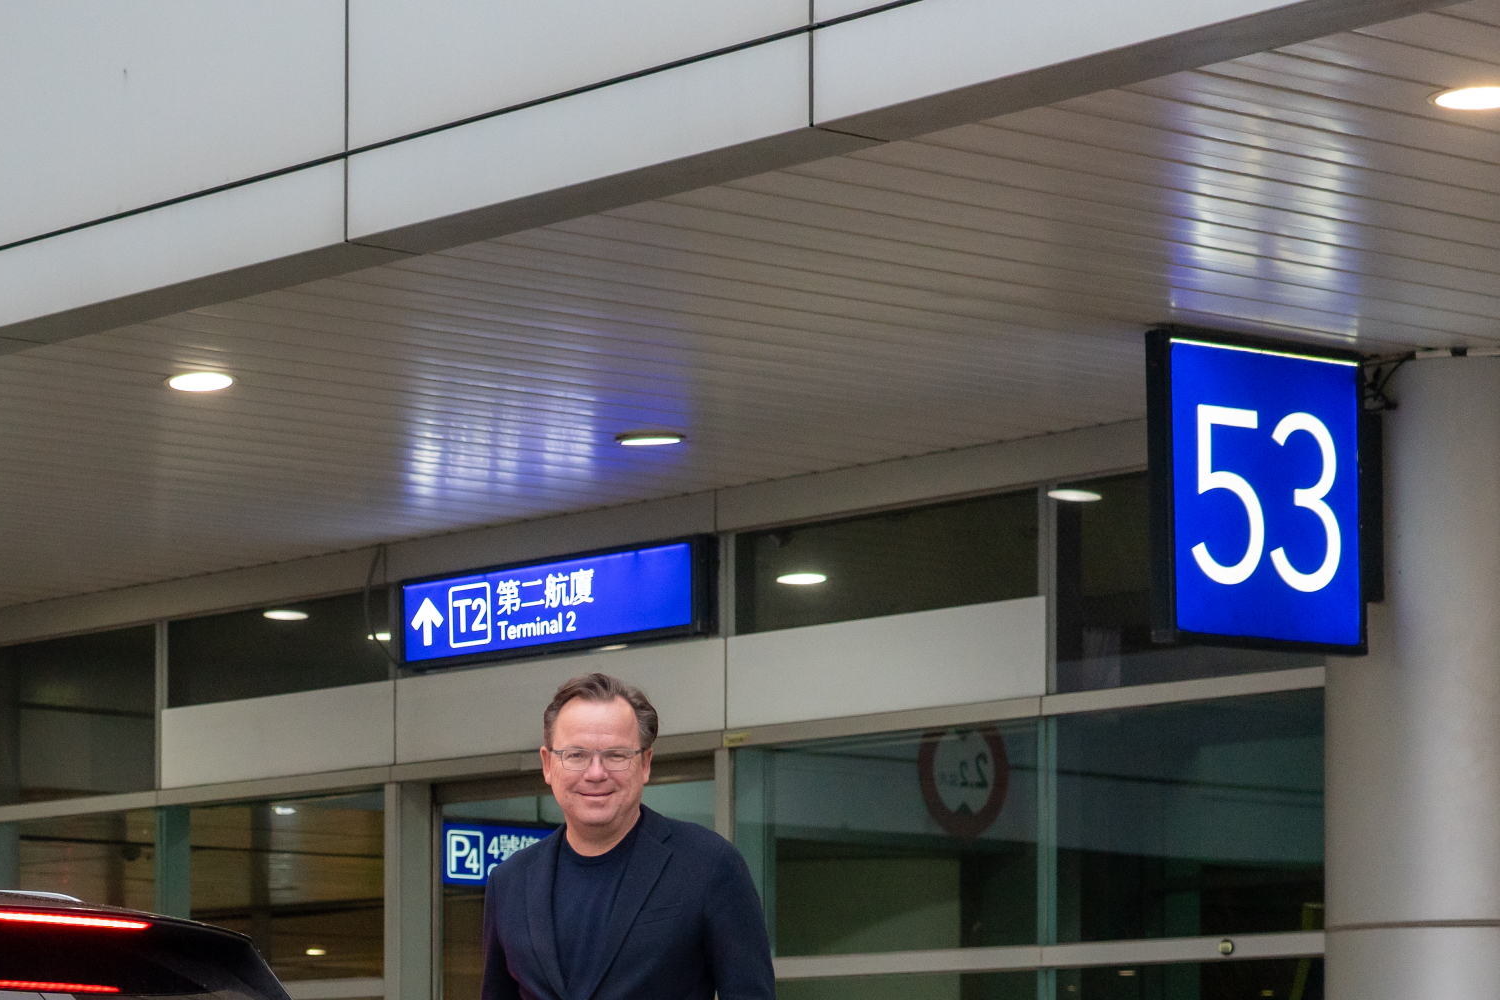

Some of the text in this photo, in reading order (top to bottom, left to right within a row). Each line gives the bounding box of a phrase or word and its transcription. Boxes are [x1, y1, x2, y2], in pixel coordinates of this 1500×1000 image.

[1191, 403, 1341, 593] 53
[496, 568, 595, 616] 第二航廈
[453, 597, 487, 634] T2
[497, 611, 577, 641] Terminal 2
[450, 835, 480, 874] P4
